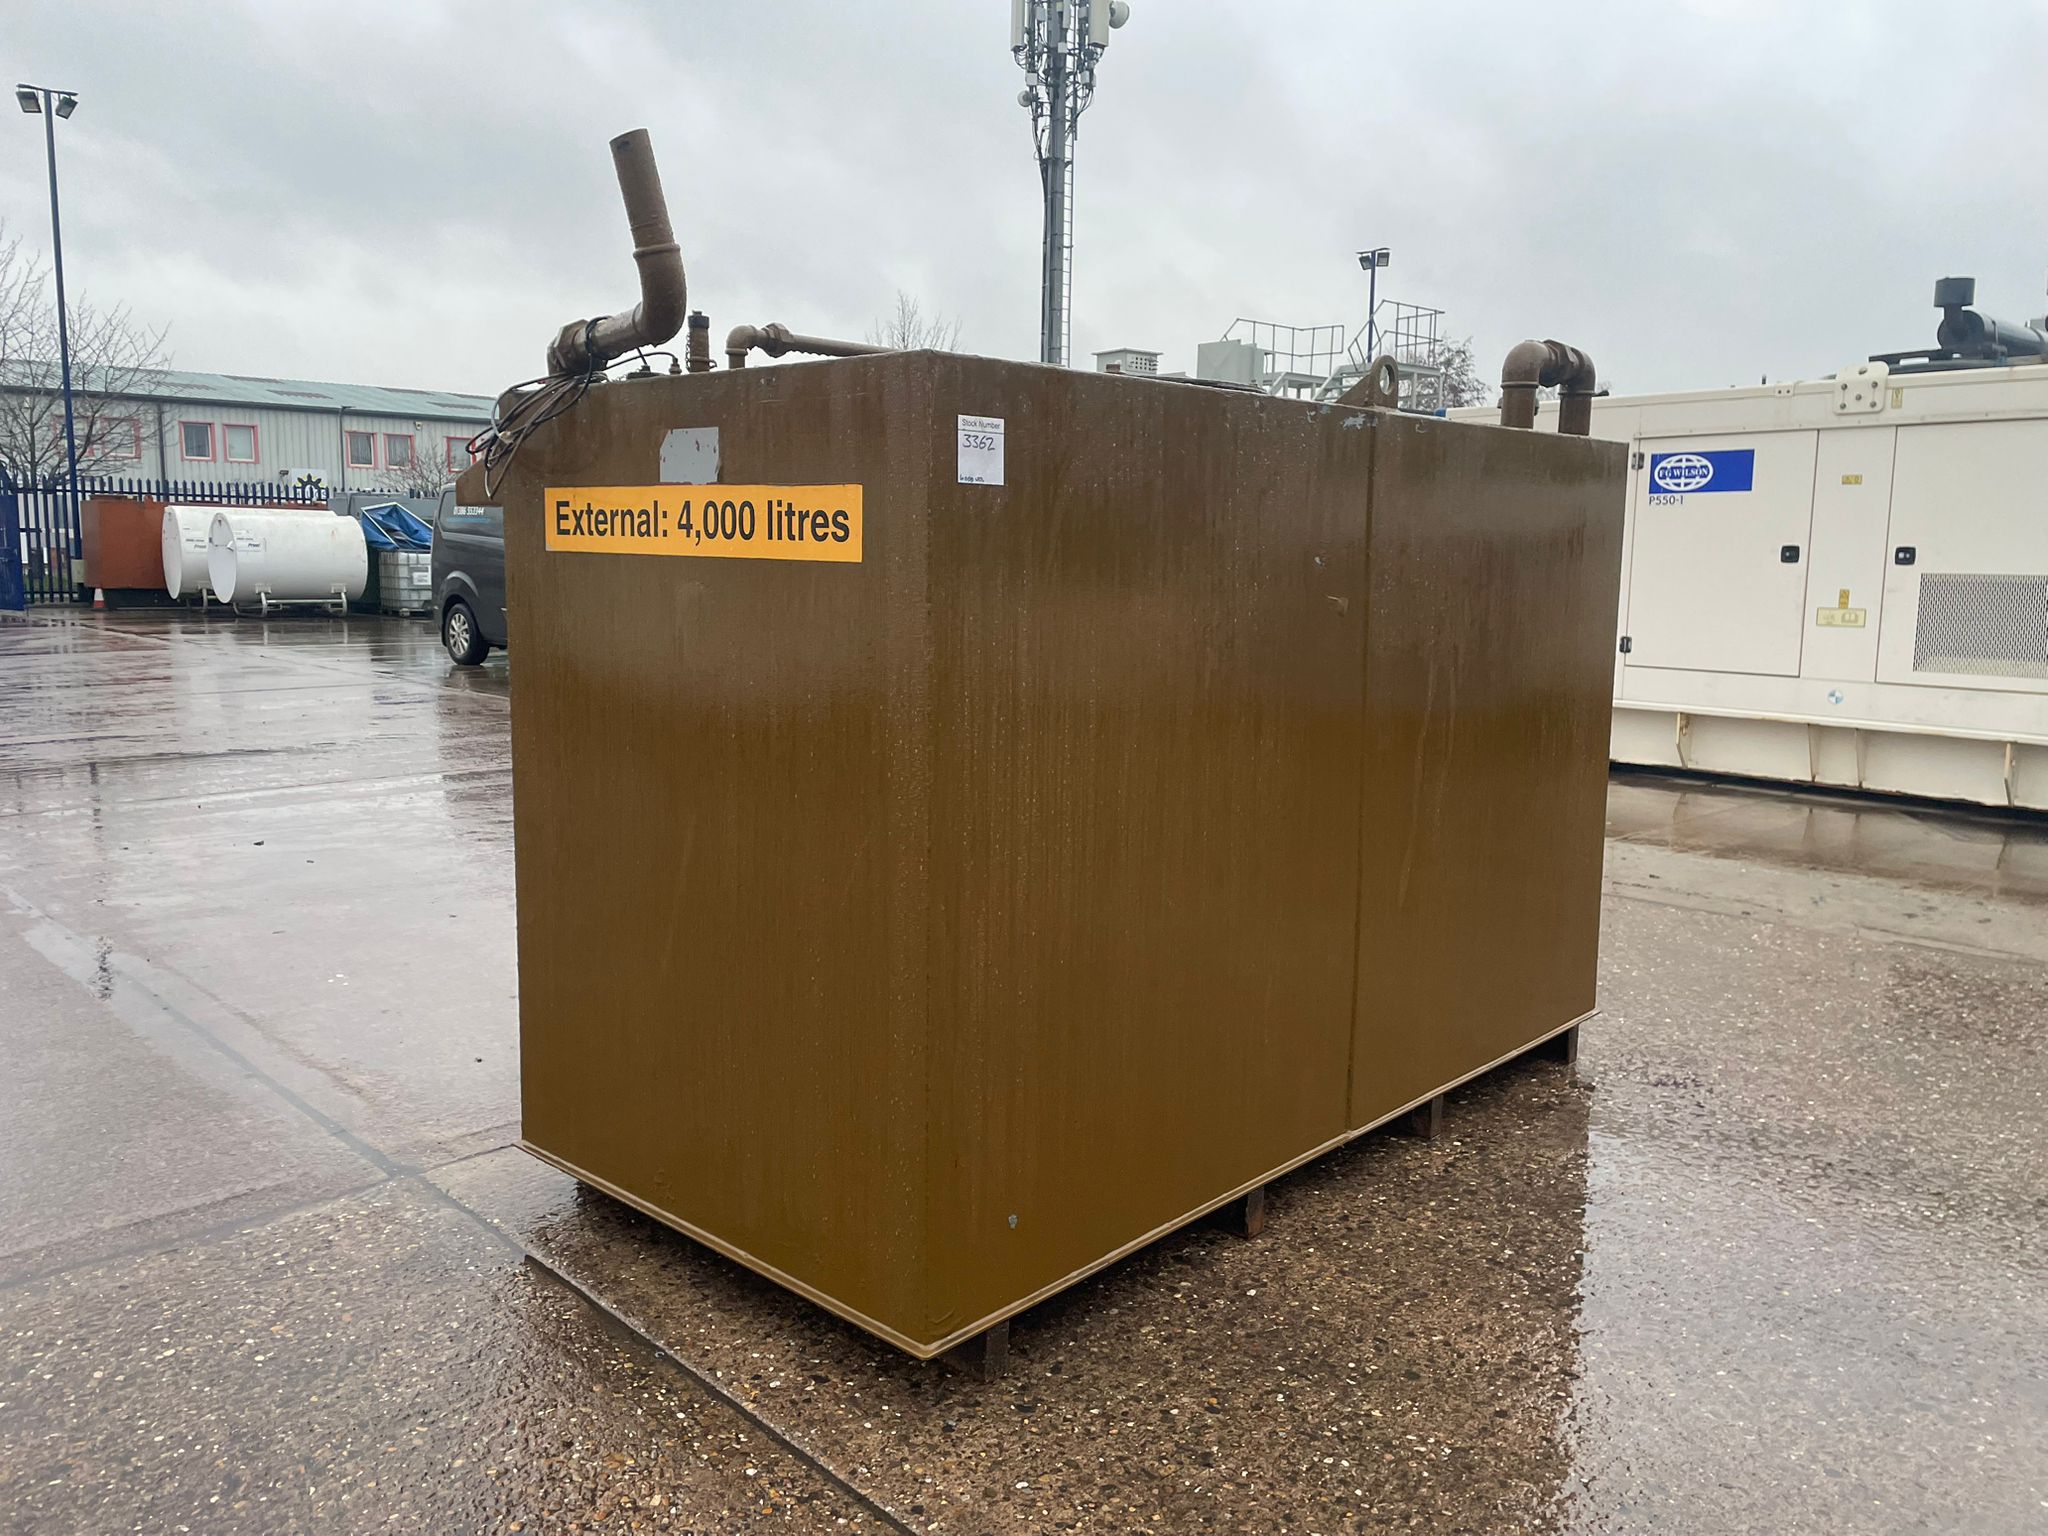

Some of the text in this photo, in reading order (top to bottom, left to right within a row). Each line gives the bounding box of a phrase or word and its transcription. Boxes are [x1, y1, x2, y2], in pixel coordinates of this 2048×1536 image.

[962, 418, 1000, 430] Stock Number
[963, 434, 995, 451] 3362
[1673, 467, 1708, 477] WILSON
[1649, 495, 1684, 505] P550-1
[556, 499, 850, 546] External: 4,000 litres
